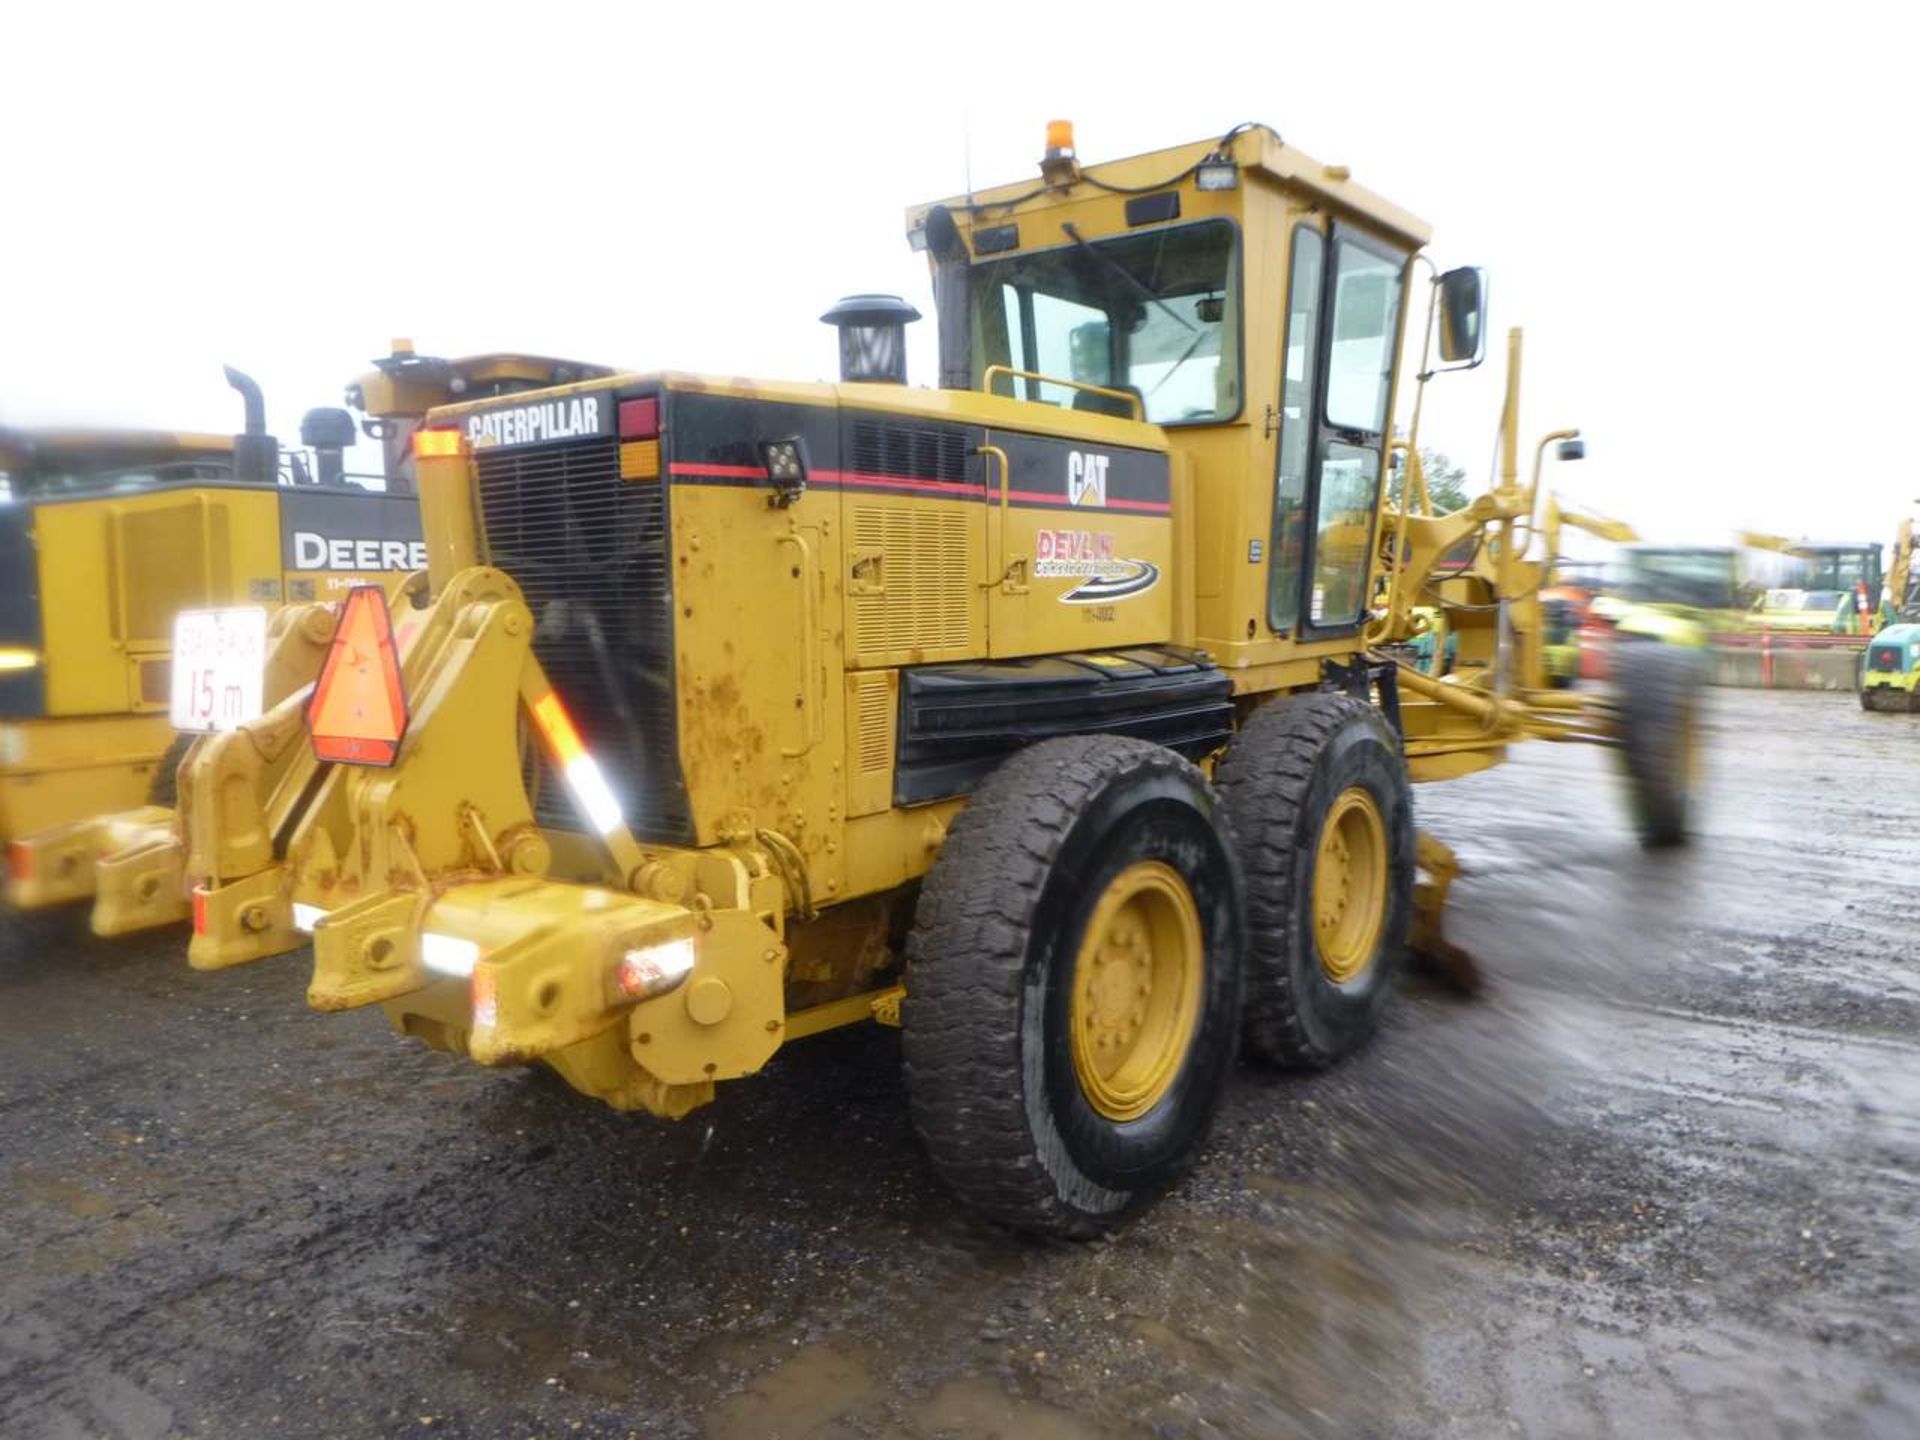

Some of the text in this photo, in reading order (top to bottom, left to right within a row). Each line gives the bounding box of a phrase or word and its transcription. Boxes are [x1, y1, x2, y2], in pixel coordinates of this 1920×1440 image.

[469, 398, 599, 448] CATERPILLAR
[1068, 451, 1109, 507] CAT
[294, 532, 427, 570] DEERE
[1037, 530, 1115, 560] DEVLIN
[191, 669, 214, 717] 15
